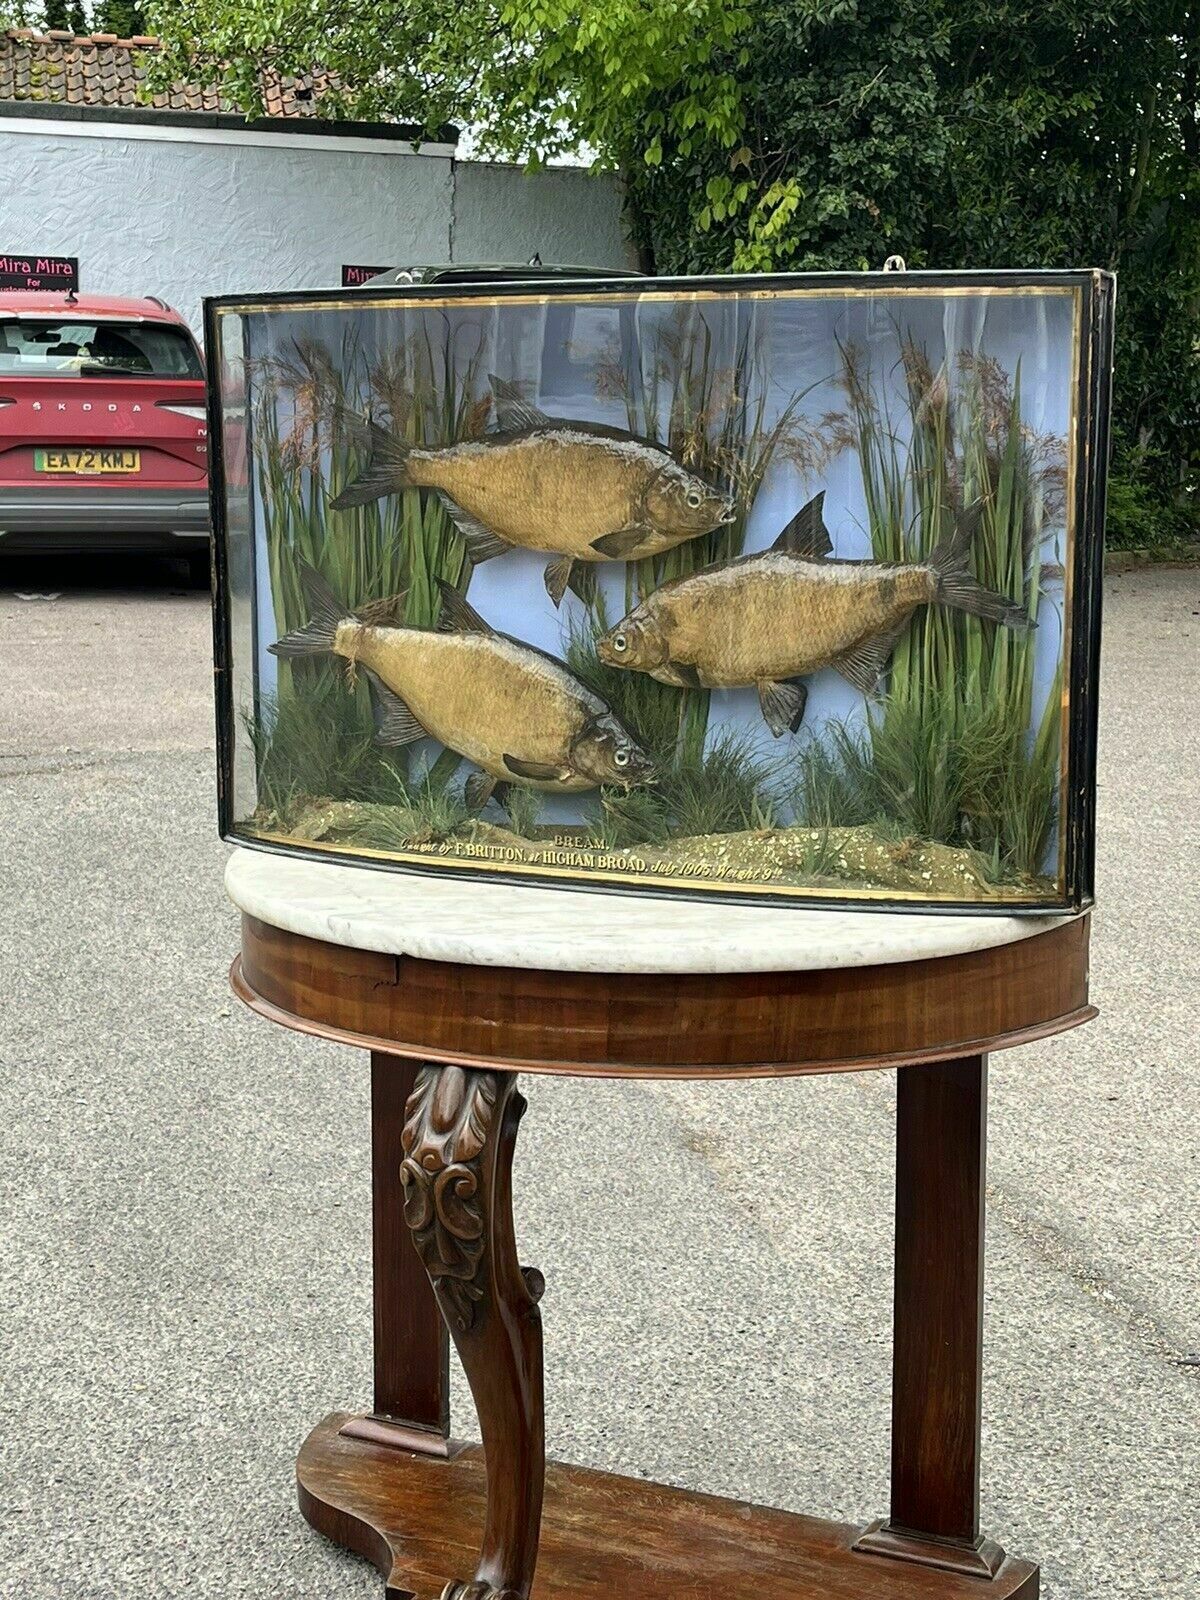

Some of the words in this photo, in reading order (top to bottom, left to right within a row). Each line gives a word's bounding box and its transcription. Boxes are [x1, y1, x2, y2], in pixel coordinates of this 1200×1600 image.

[36, 259, 73, 275] Mira
[27, 278, 41, 287] For
[47, 451, 95, 468] EA72
[101, 452, 137, 469] KMJ
[439, 842, 454, 856] by
[542, 850, 595, 868] HIGHAM
[650, 860, 678, 876] July
